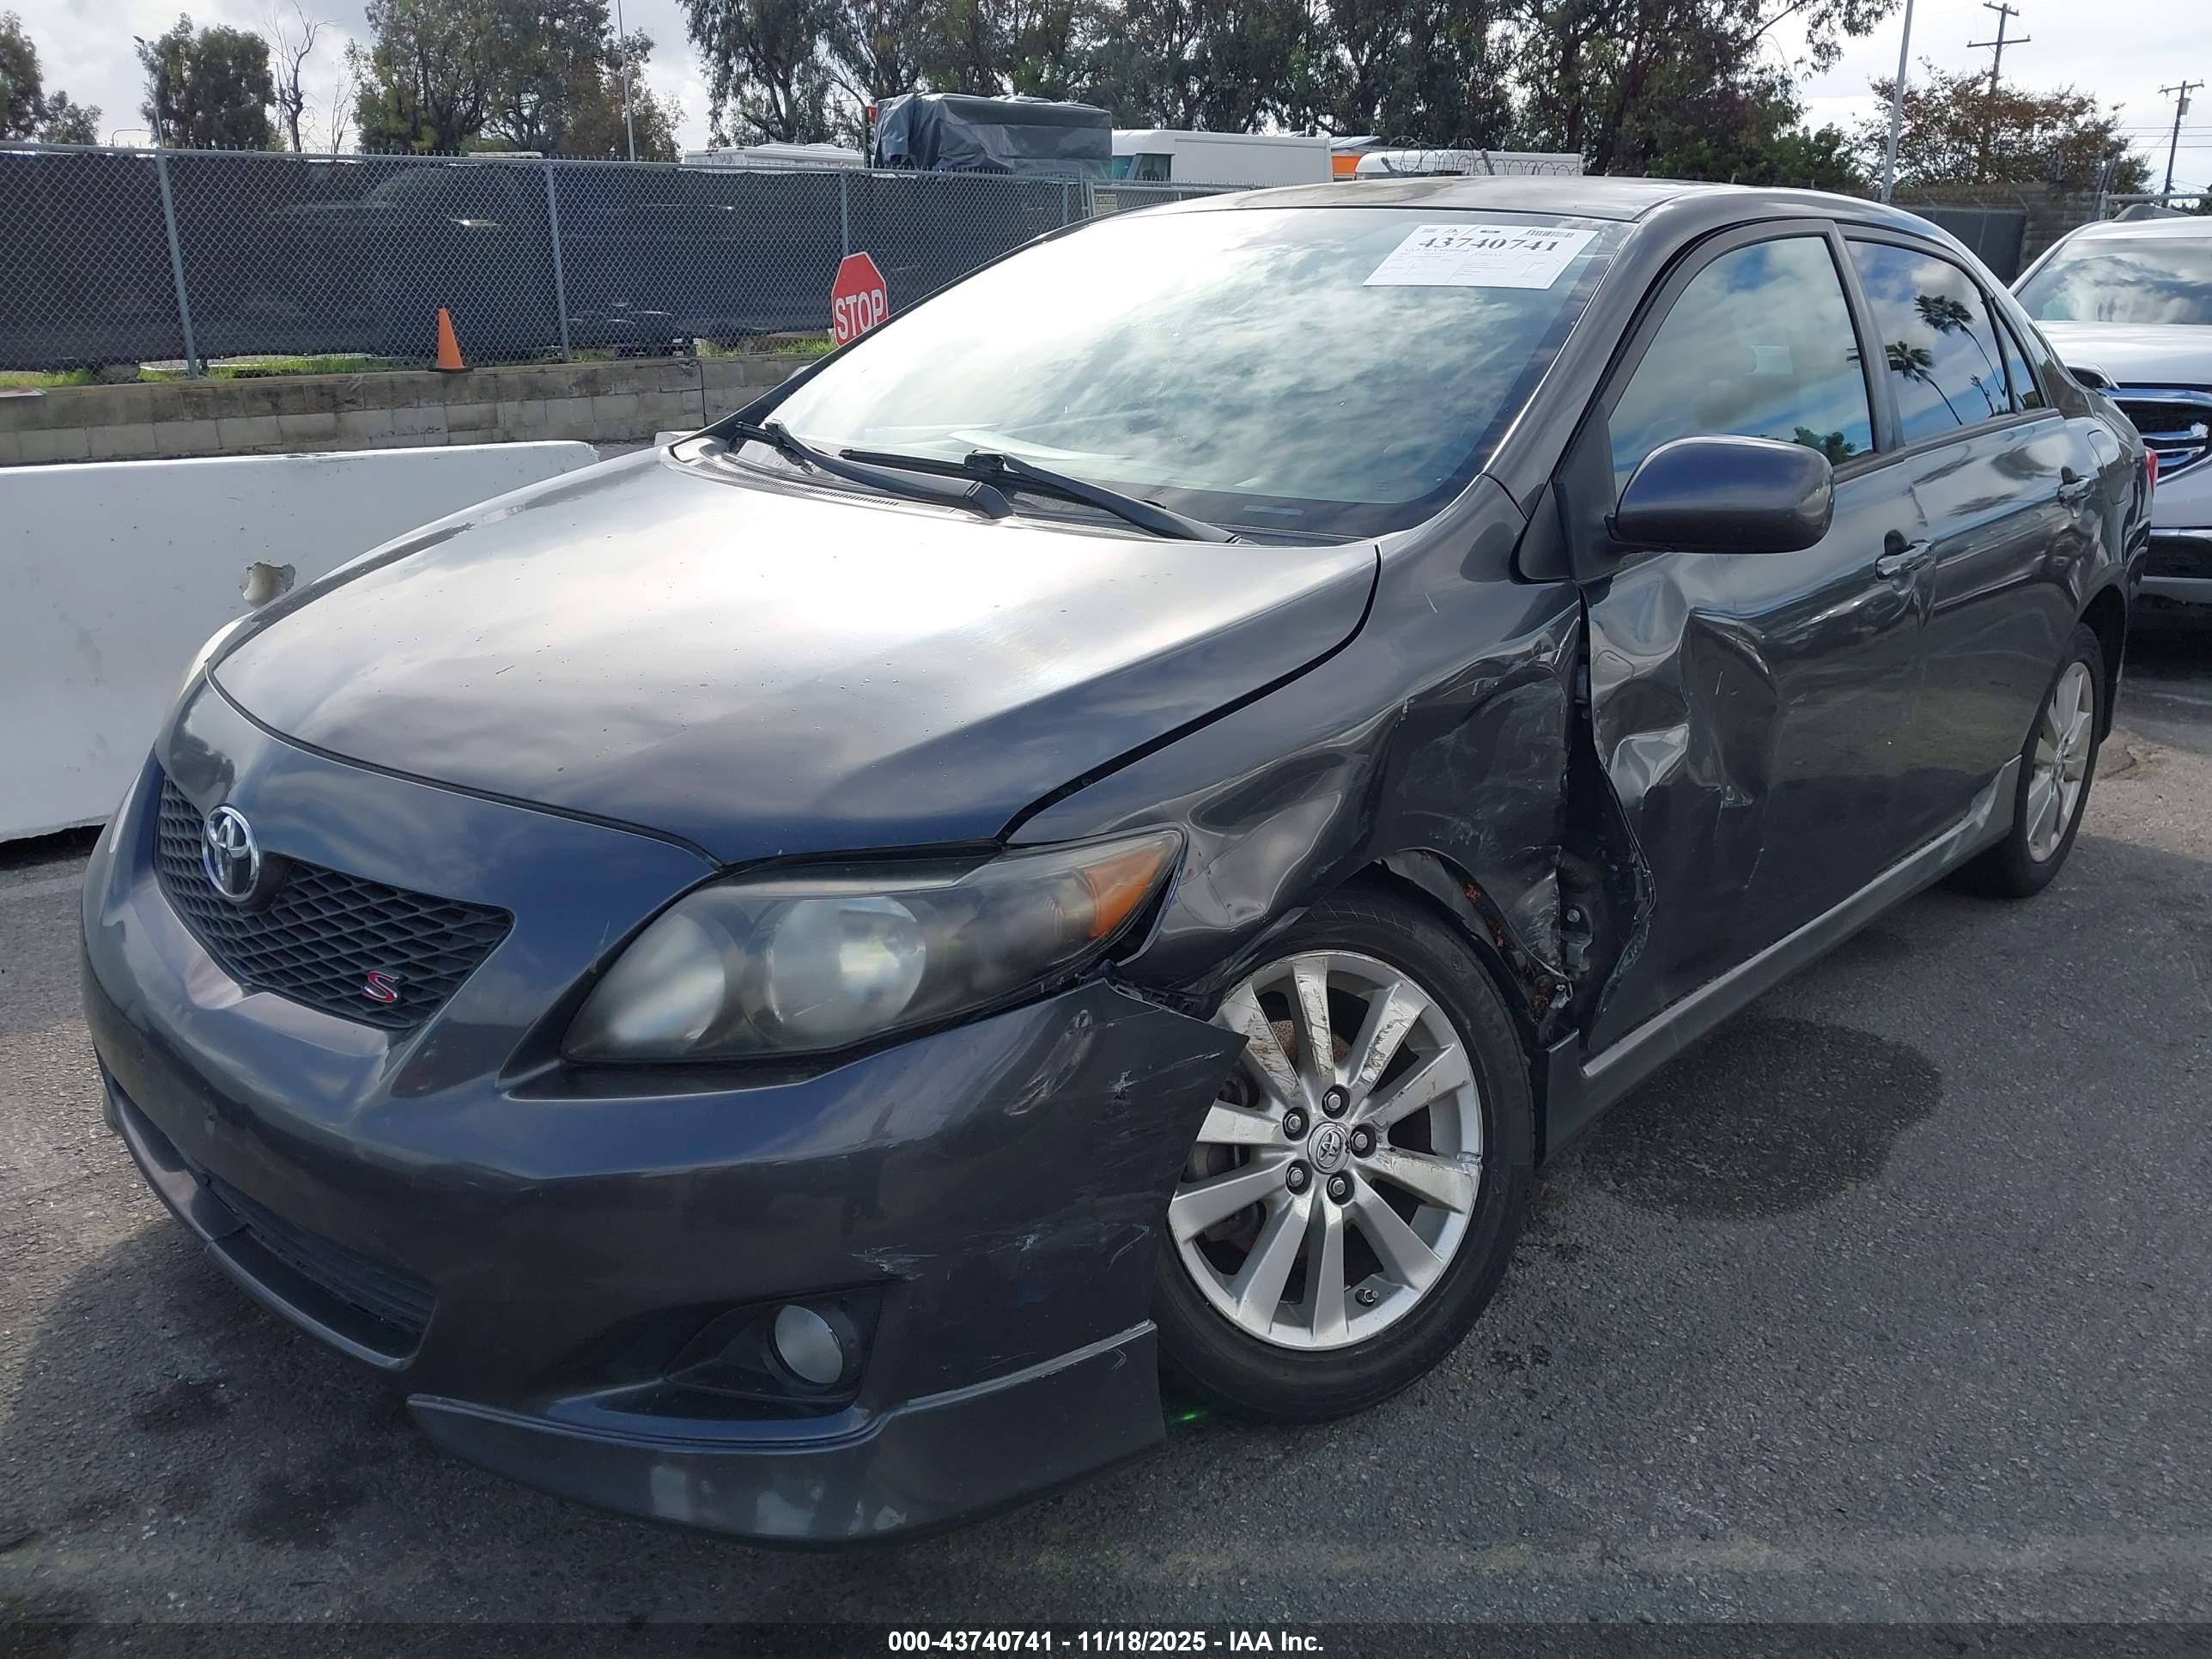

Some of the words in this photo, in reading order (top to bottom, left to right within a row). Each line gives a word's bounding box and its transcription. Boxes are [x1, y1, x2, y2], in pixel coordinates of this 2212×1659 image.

[1418, 236, 1559, 252] 43740741
[835, 289, 884, 340] STOP
[362, 969, 399, 1004] S
